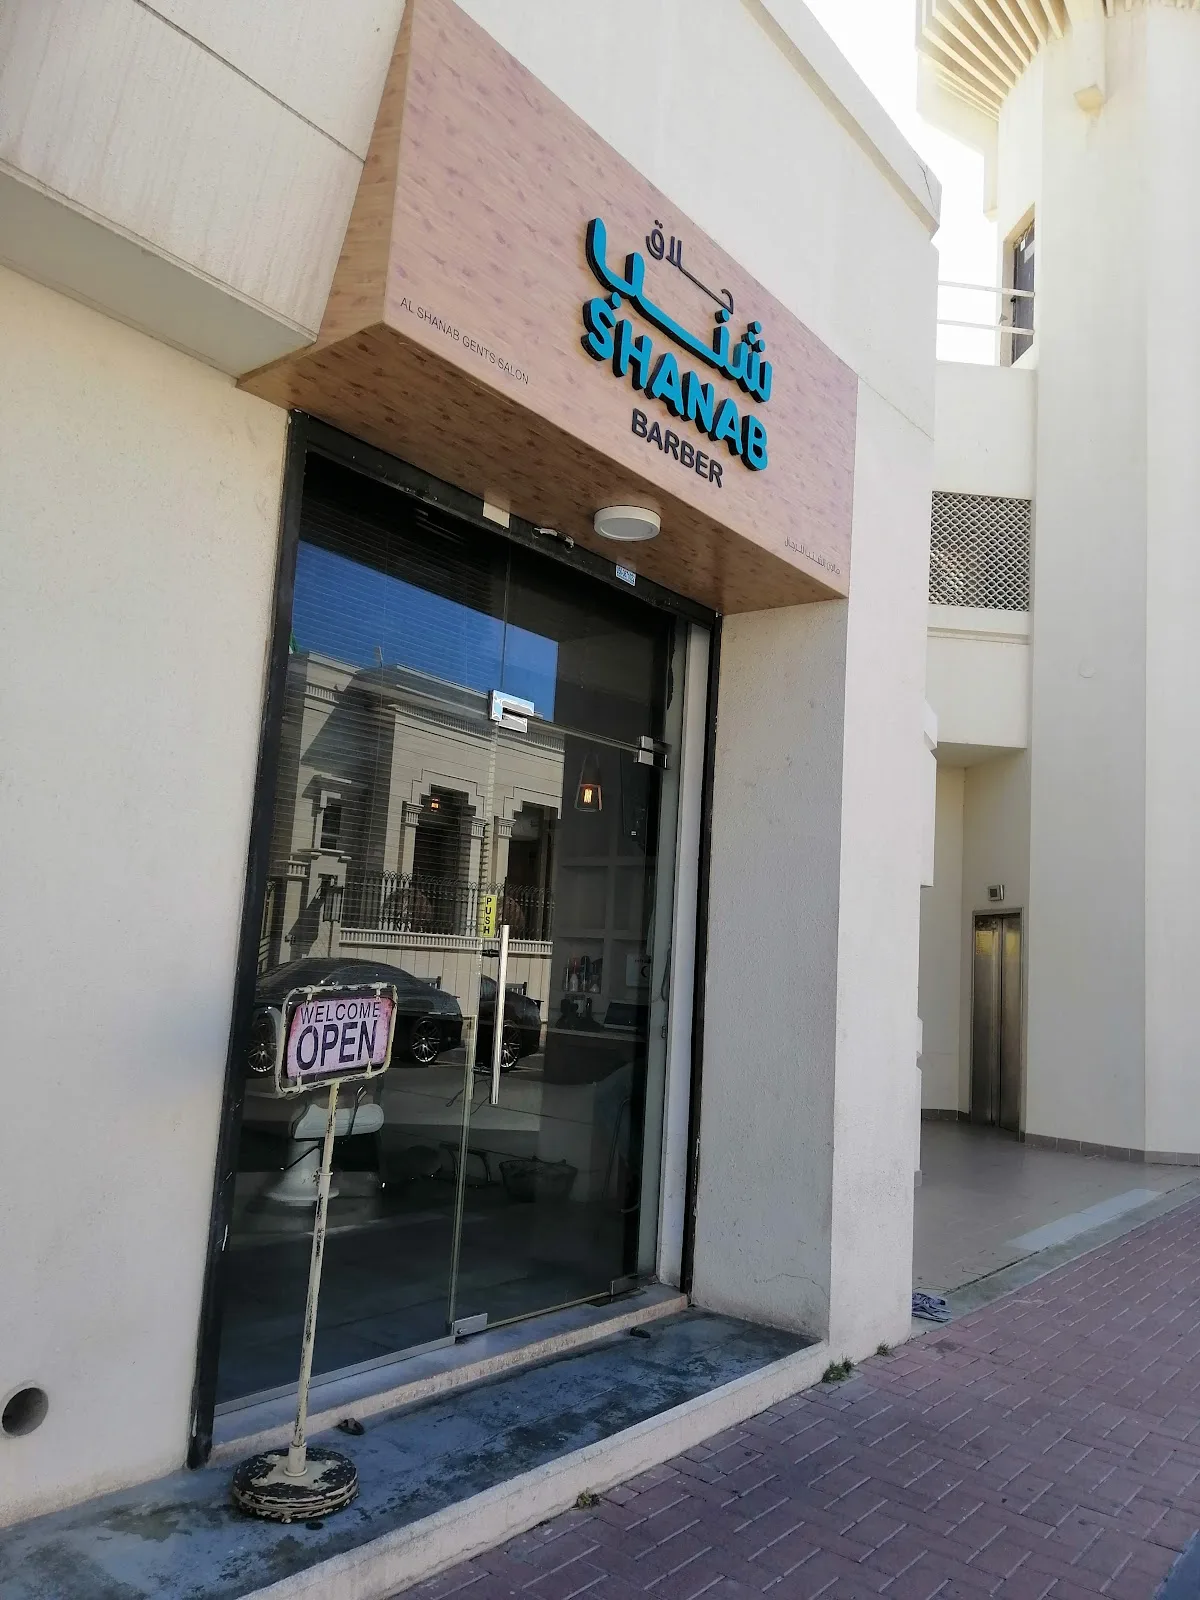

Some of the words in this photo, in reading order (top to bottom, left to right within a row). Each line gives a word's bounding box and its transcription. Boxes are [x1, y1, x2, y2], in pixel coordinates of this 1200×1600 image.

[646, 219, 734, 315] حلاق
[400, 297, 414, 314] AL
[416, 306, 460, 341] SHANAB
[462, 335, 496, 364] GENTS
[497, 357, 529, 385] SALON
[585, 217, 773, 403] شنب
[581, 297, 769, 471] SHANAB
[631, 408, 723, 488] BARBER
[483, 897, 492, 935] PUSH
[296, 1019, 378, 1071] OPEN
[300, 1001, 382, 1025] WELCOME
